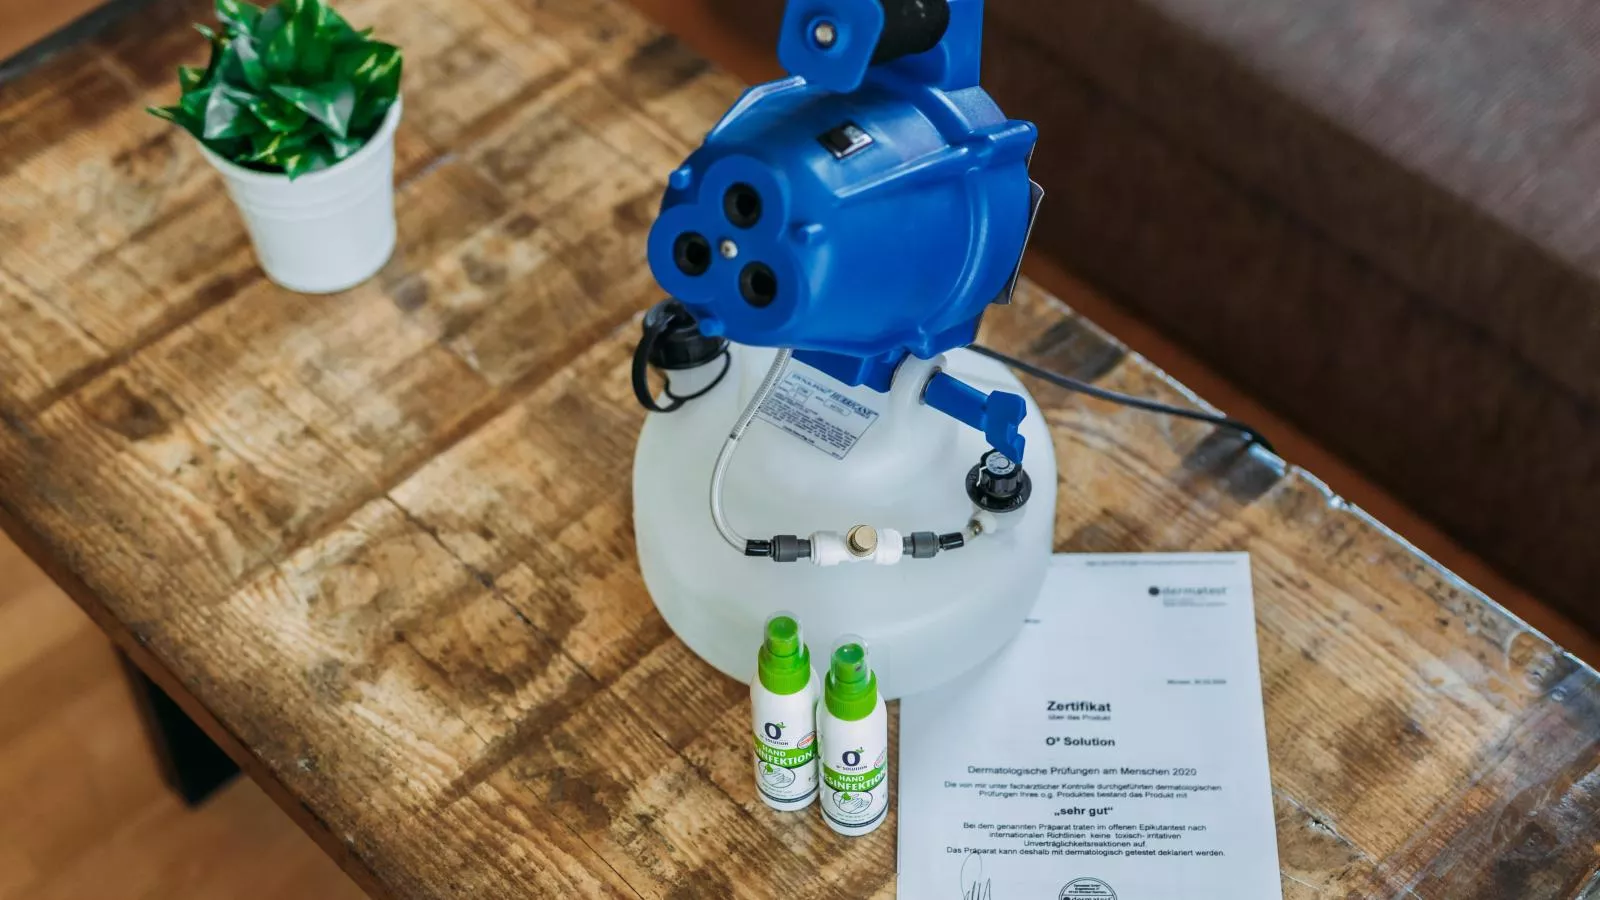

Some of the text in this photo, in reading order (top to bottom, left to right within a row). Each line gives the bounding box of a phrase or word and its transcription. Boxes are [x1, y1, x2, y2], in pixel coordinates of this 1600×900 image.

[1047, 701, 1111, 712] Zertifikat
[1064, 737, 1115, 746] Solution
[968, 766, 1047, 776] Dermatologische
[1051, 767, 1099, 777] Prüfungen
[1120, 767, 1169, 776] Menschen
[1172, 768, 1197, 776] 2020
[997, 823, 1036, 831] genannten
[1039, 823, 1071, 831] Präparat
[1139, 824, 1186, 832] Epikutantest
[964, 847, 997, 855] Präparat
[1065, 849, 1123, 857] dermatologisch
[1125, 850, 1156, 858] getestet
